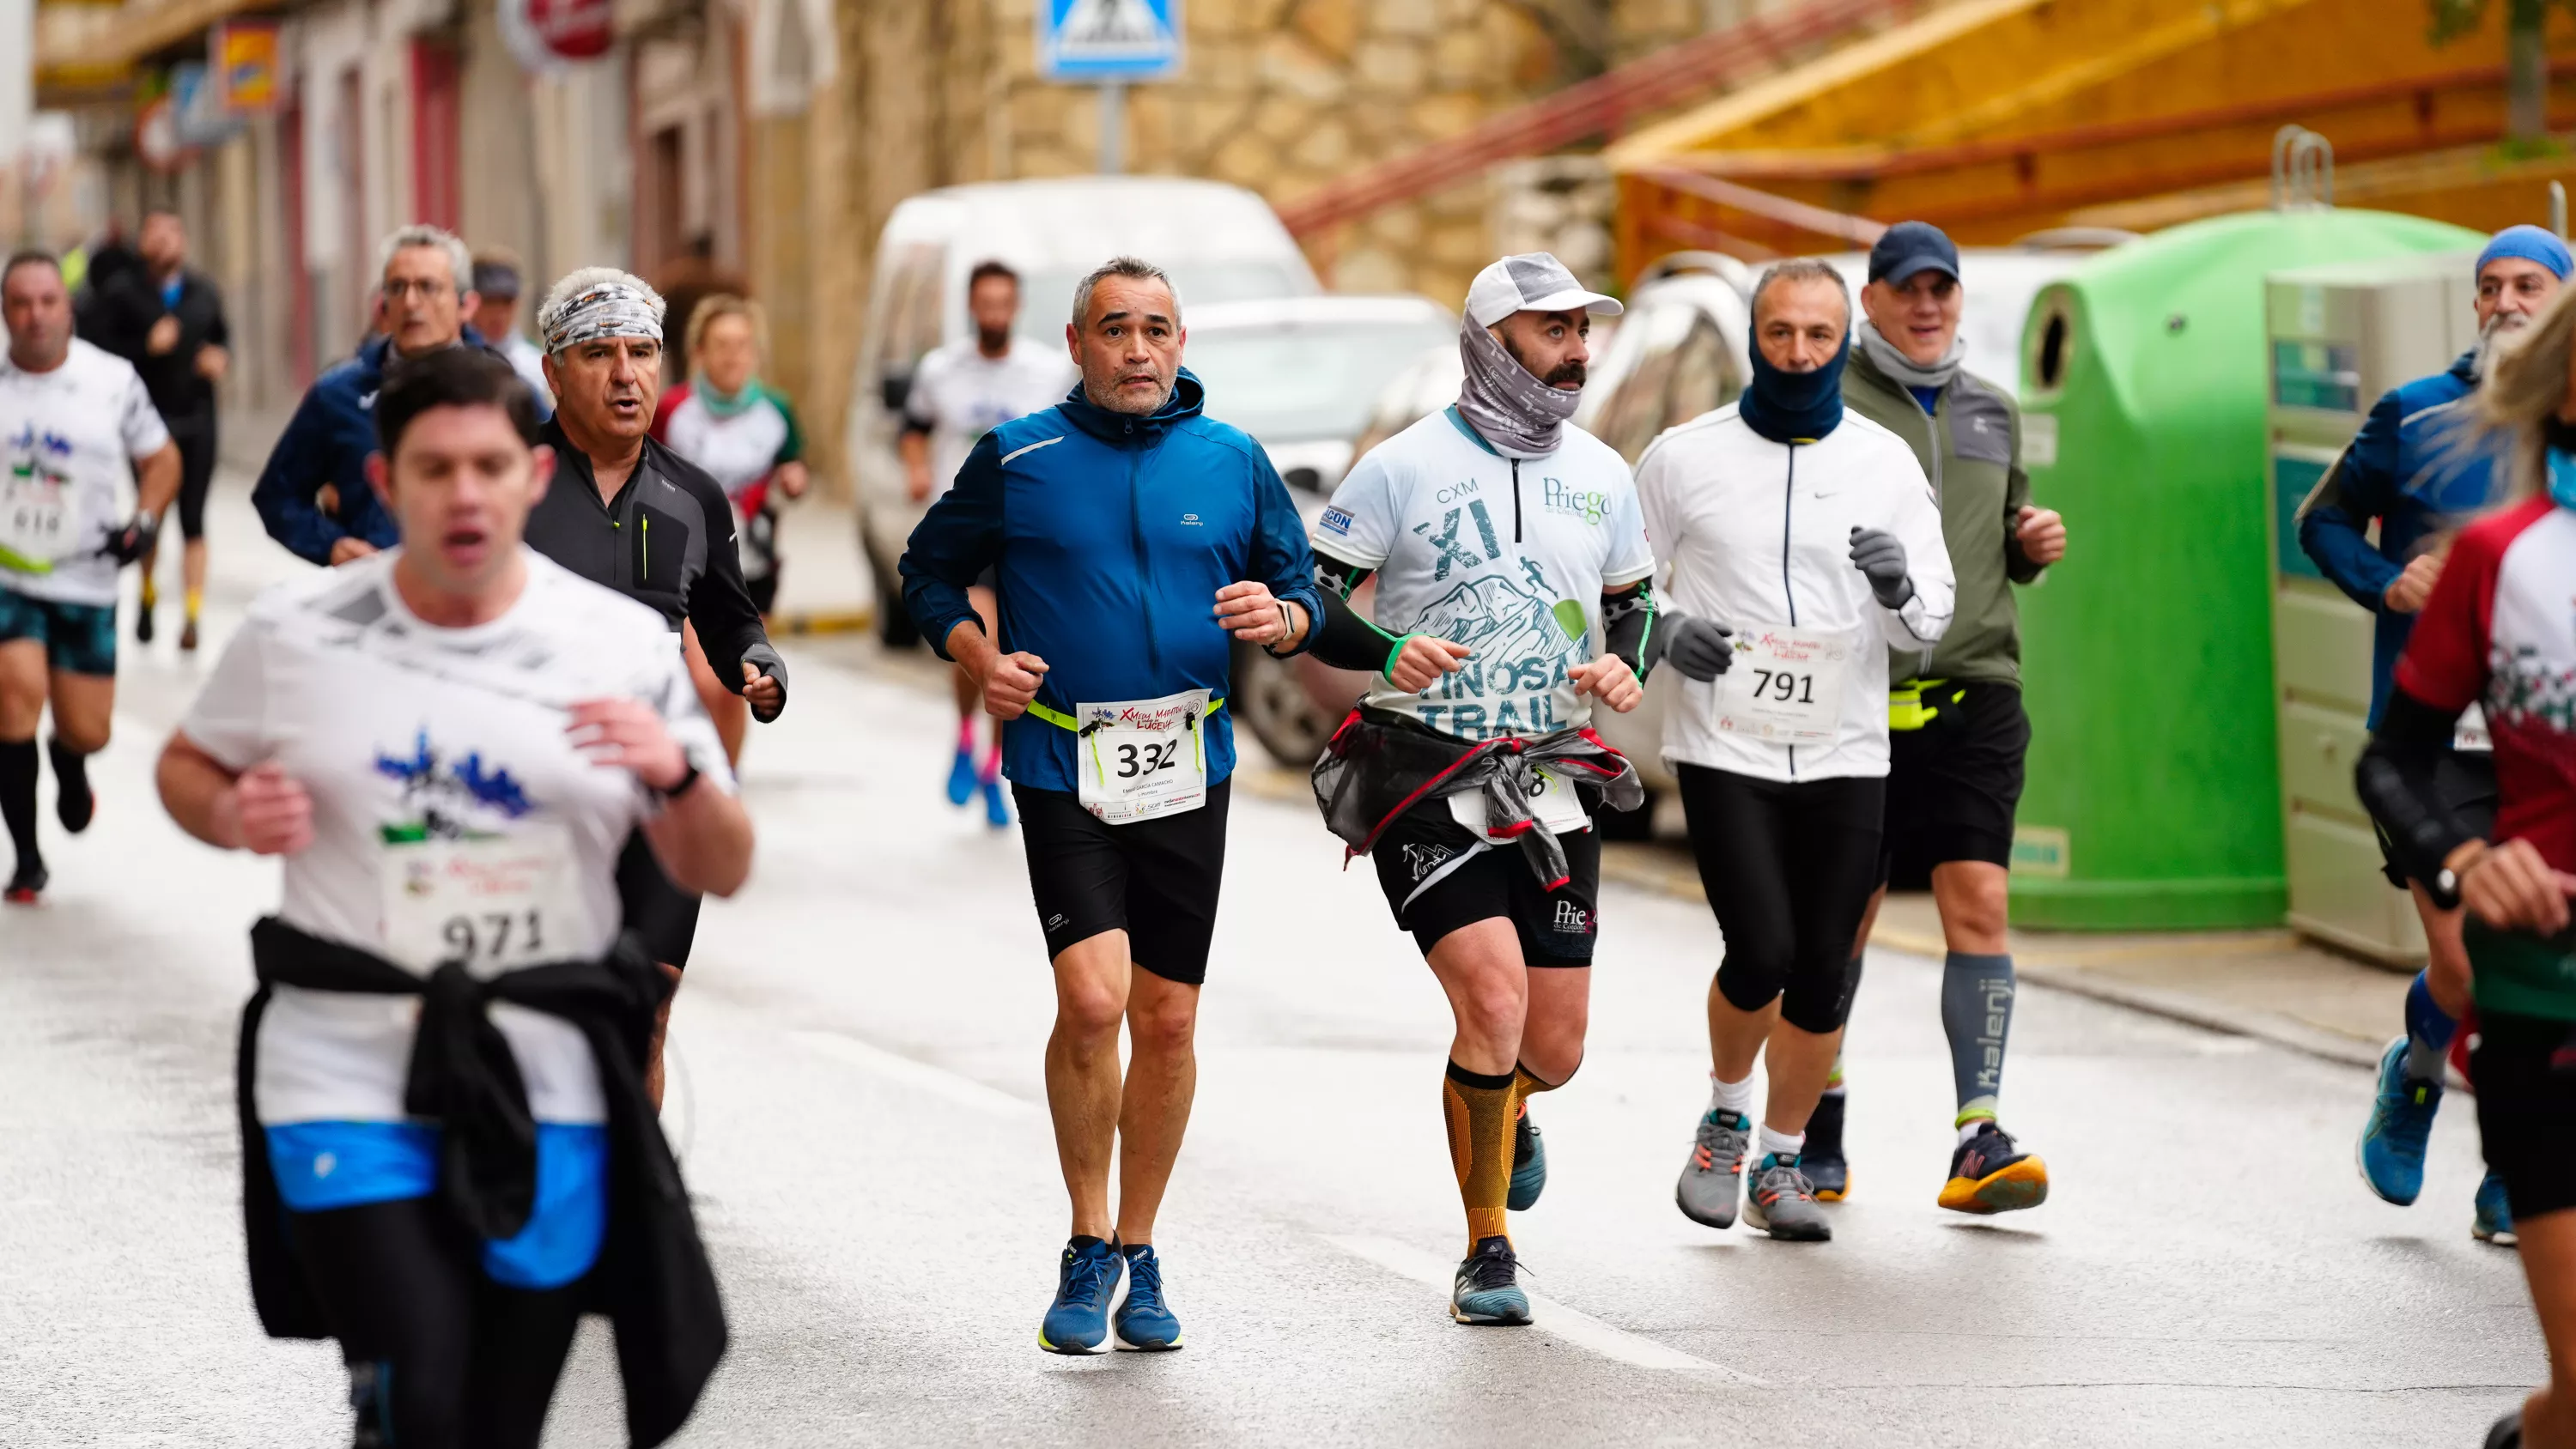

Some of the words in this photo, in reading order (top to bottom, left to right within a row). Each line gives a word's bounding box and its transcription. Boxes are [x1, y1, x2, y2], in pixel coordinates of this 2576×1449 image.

[1437, 477, 1479, 504] CXM
[1413, 498, 1502, 582] XI
[1419, 651, 1577, 700] IÑOSA
[1753, 667, 1814, 704] 791
[1136, 719, 1175, 731] LUCENA
[1417, 693, 1568, 741] TRAIL
[1117, 738, 1178, 779] 332
[443, 910, 543, 961] 971
